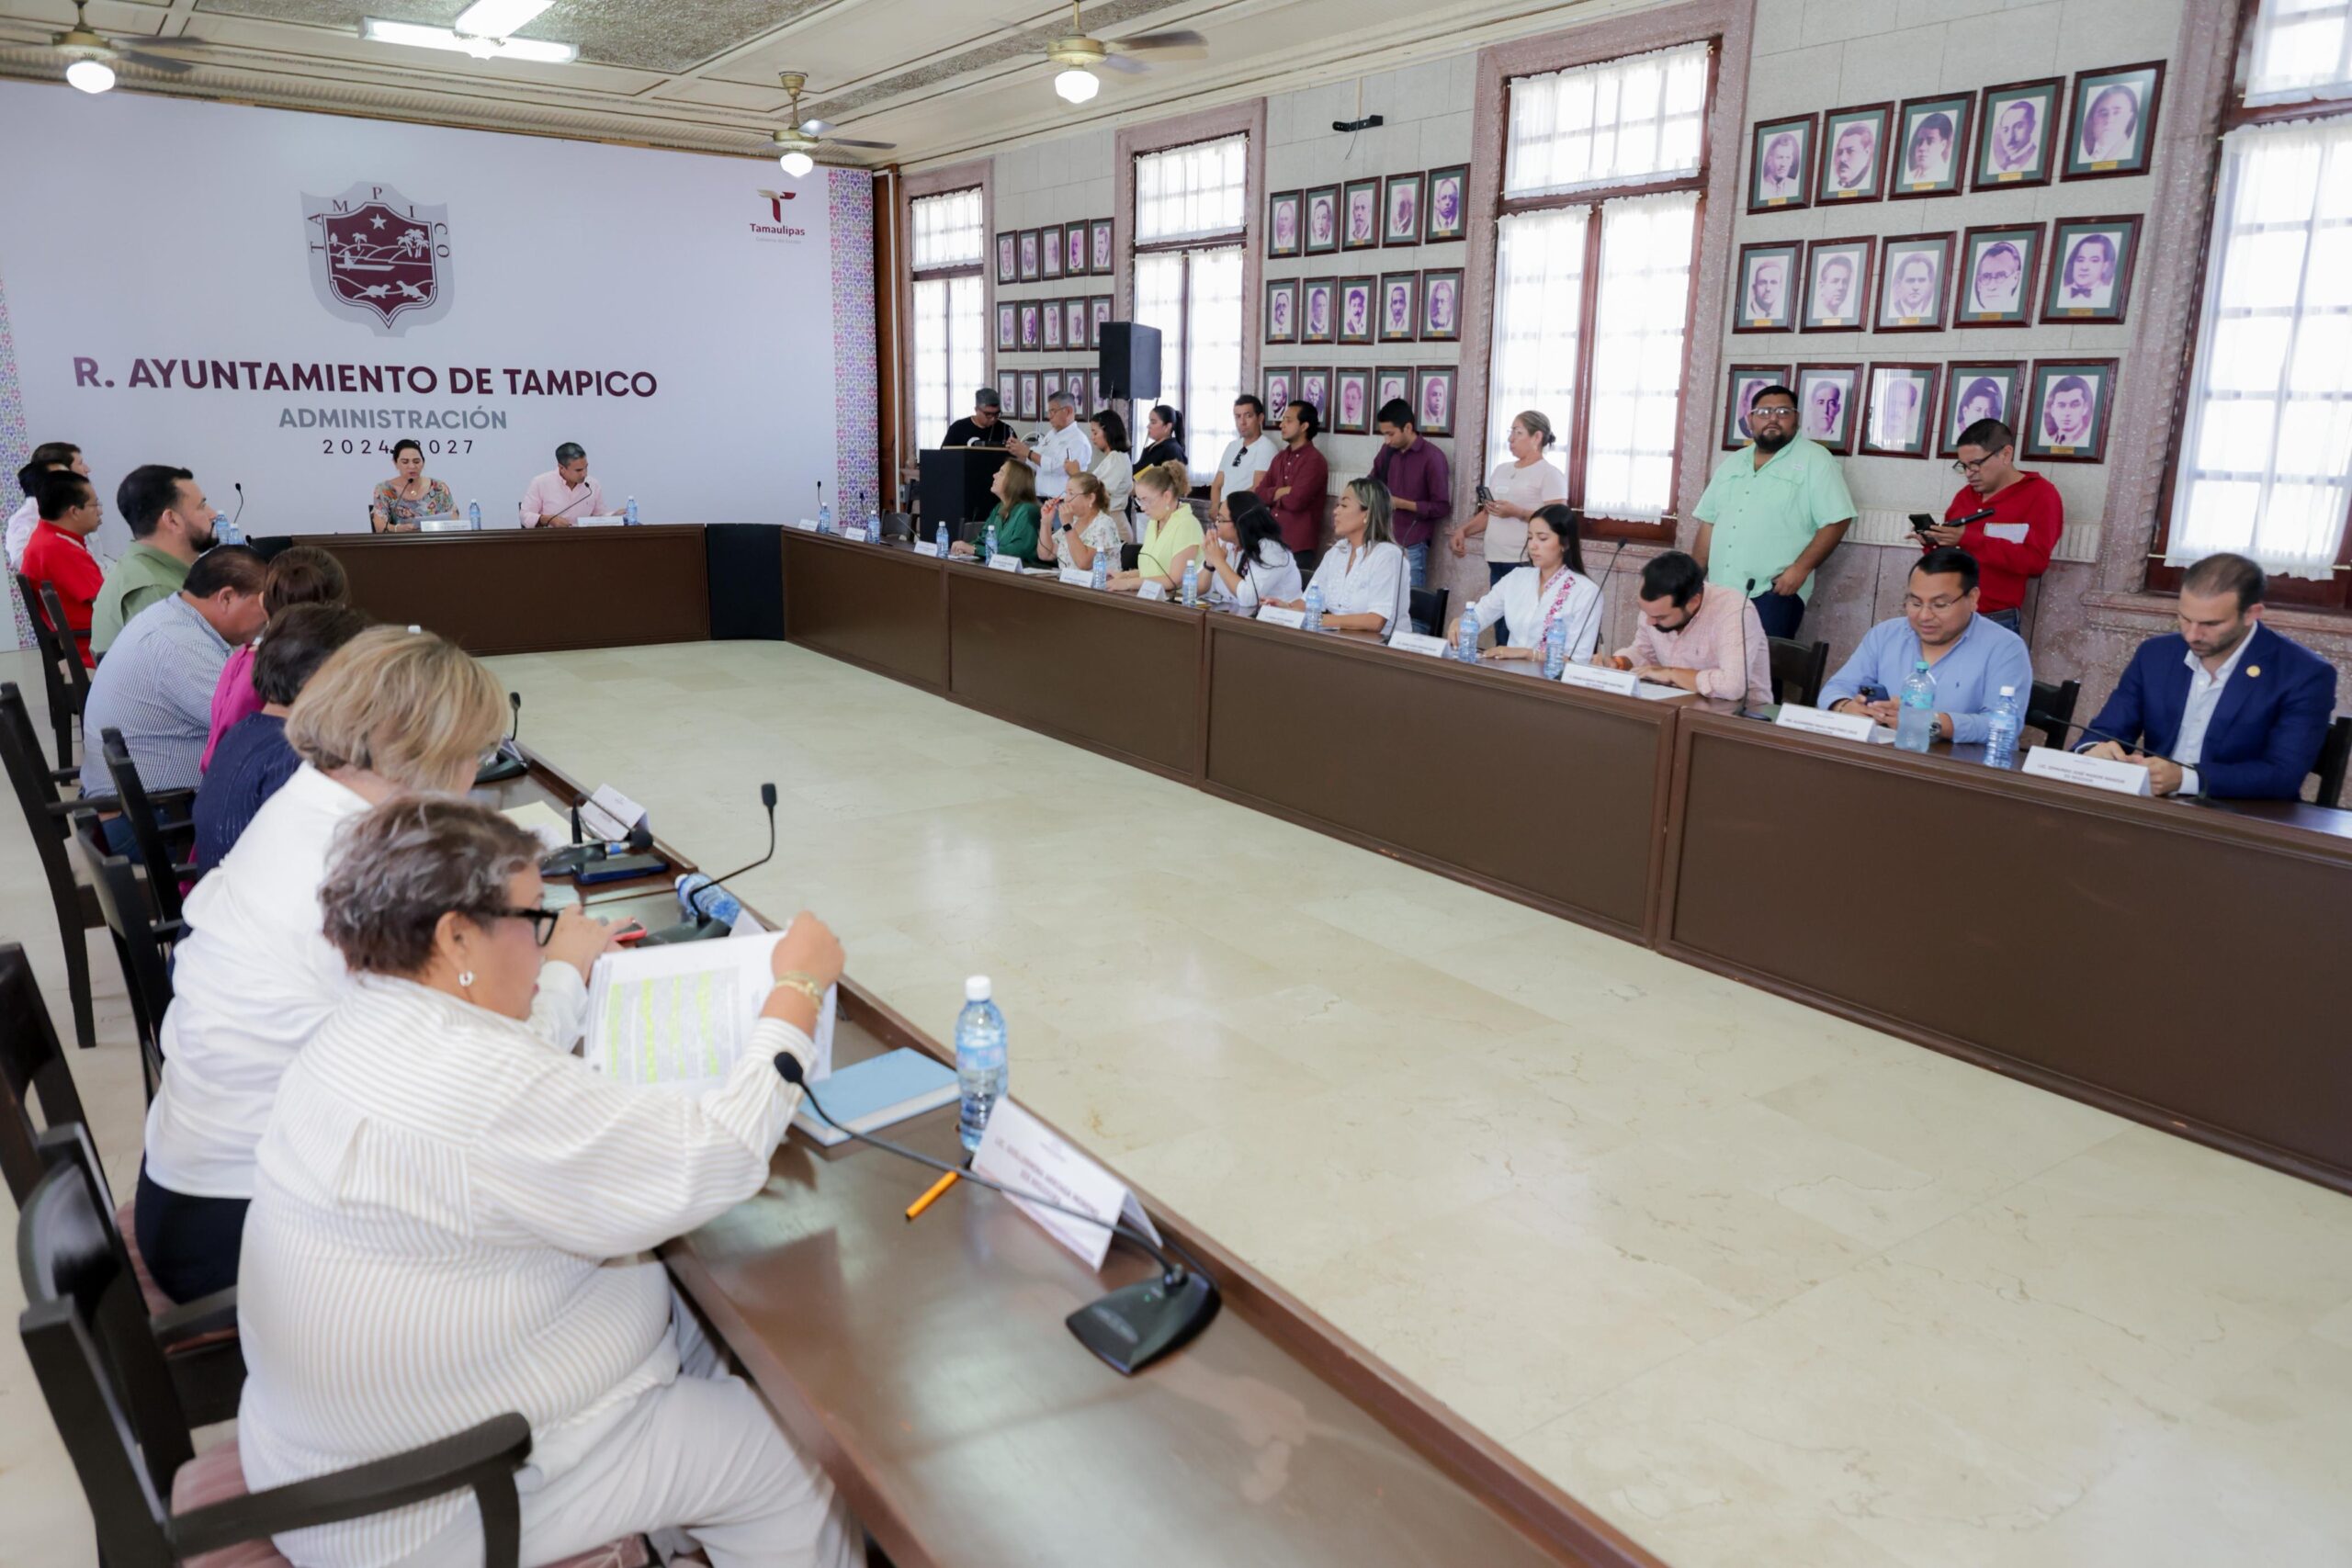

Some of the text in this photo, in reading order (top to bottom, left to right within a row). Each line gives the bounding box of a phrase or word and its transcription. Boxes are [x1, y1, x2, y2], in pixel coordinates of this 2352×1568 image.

[750, 223, 805, 237] Tamaulipas
[74, 356, 658, 398] R. AYUNTAMIENTO DE TAMPICO
[278, 405, 507, 430] ADMINISTRACIÓN
